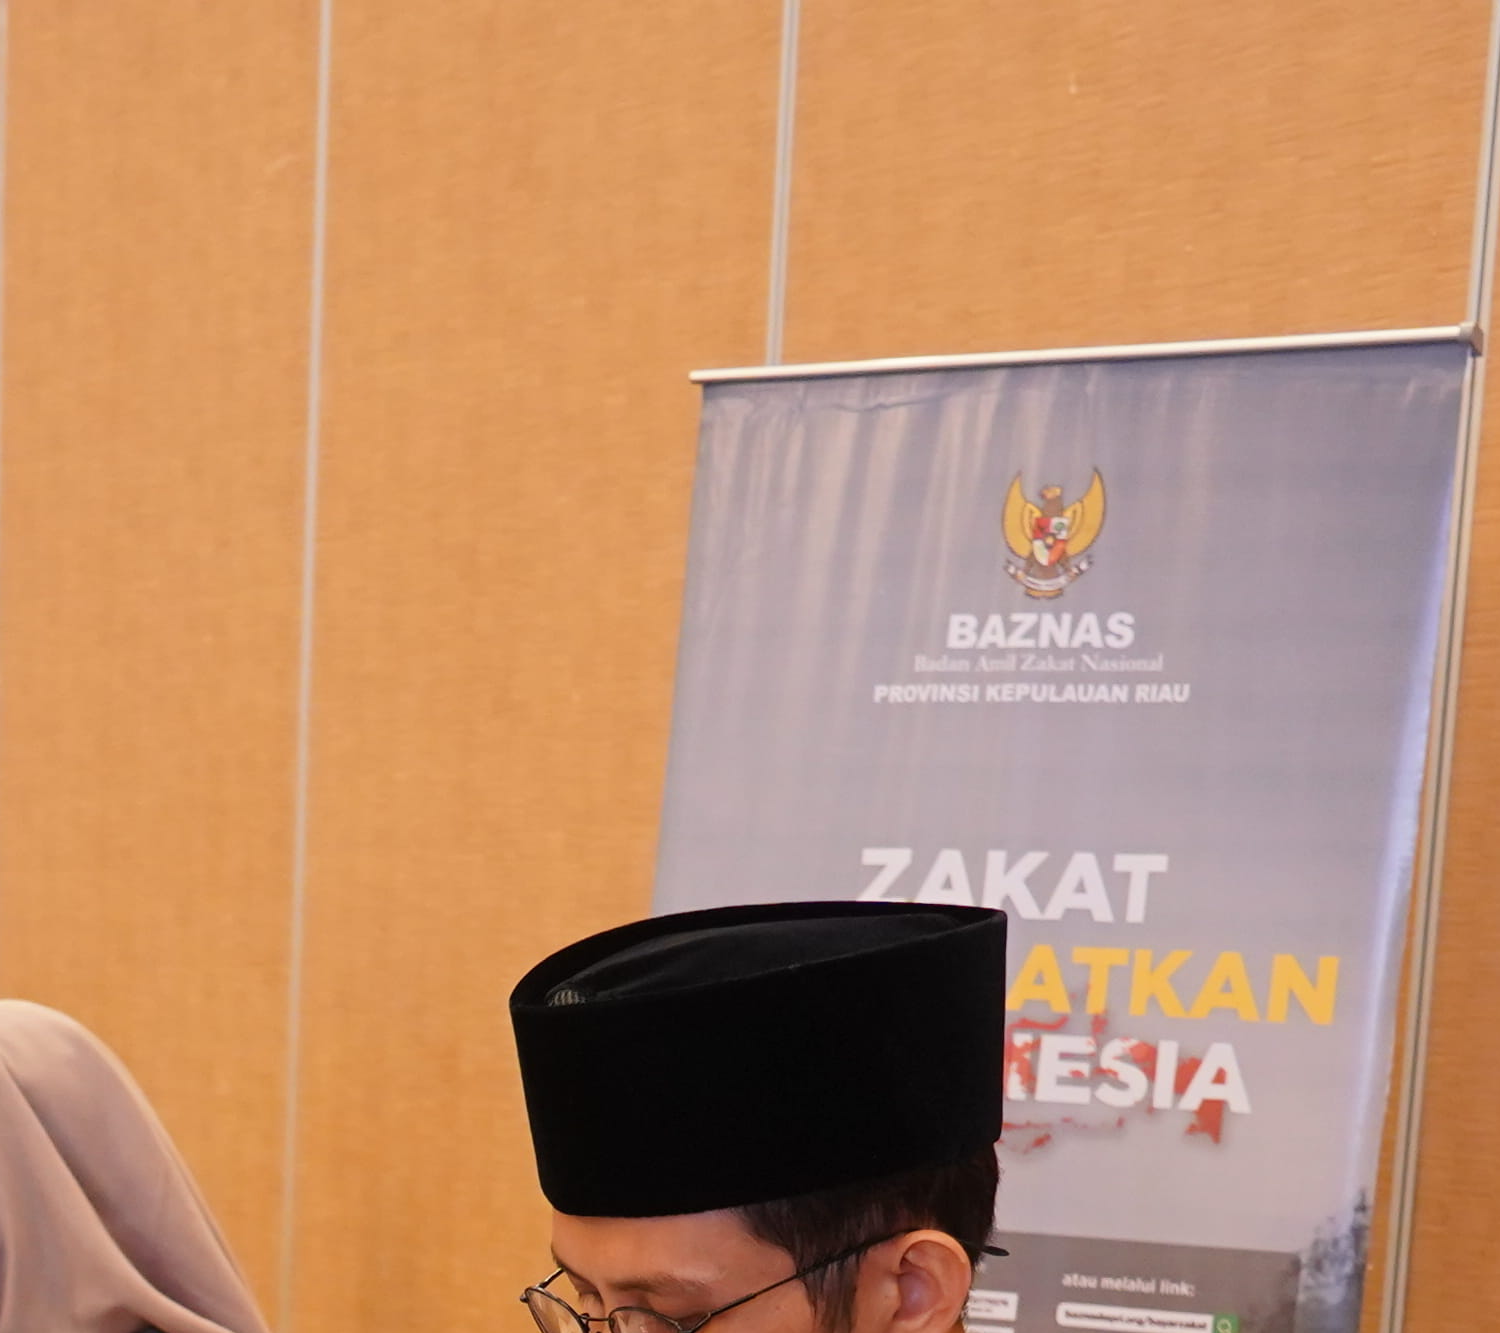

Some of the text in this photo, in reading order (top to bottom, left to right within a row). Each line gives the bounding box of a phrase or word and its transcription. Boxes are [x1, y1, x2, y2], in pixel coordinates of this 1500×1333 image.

[947, 612, 1135, 649] BAZNAS
[914, 655, 970, 673] Badan
[1020, 654, 1075, 672] Zakat
[1081, 653, 1163, 672] Nasional
[873, 683, 1191, 703] PROVINSI KEPULAUAN RIAU
[857, 847, 1168, 923] ZAKAT
[1006, 944, 1339, 1025] ATKAN
[1062, 1274, 1195, 1297] atau melalui link:
